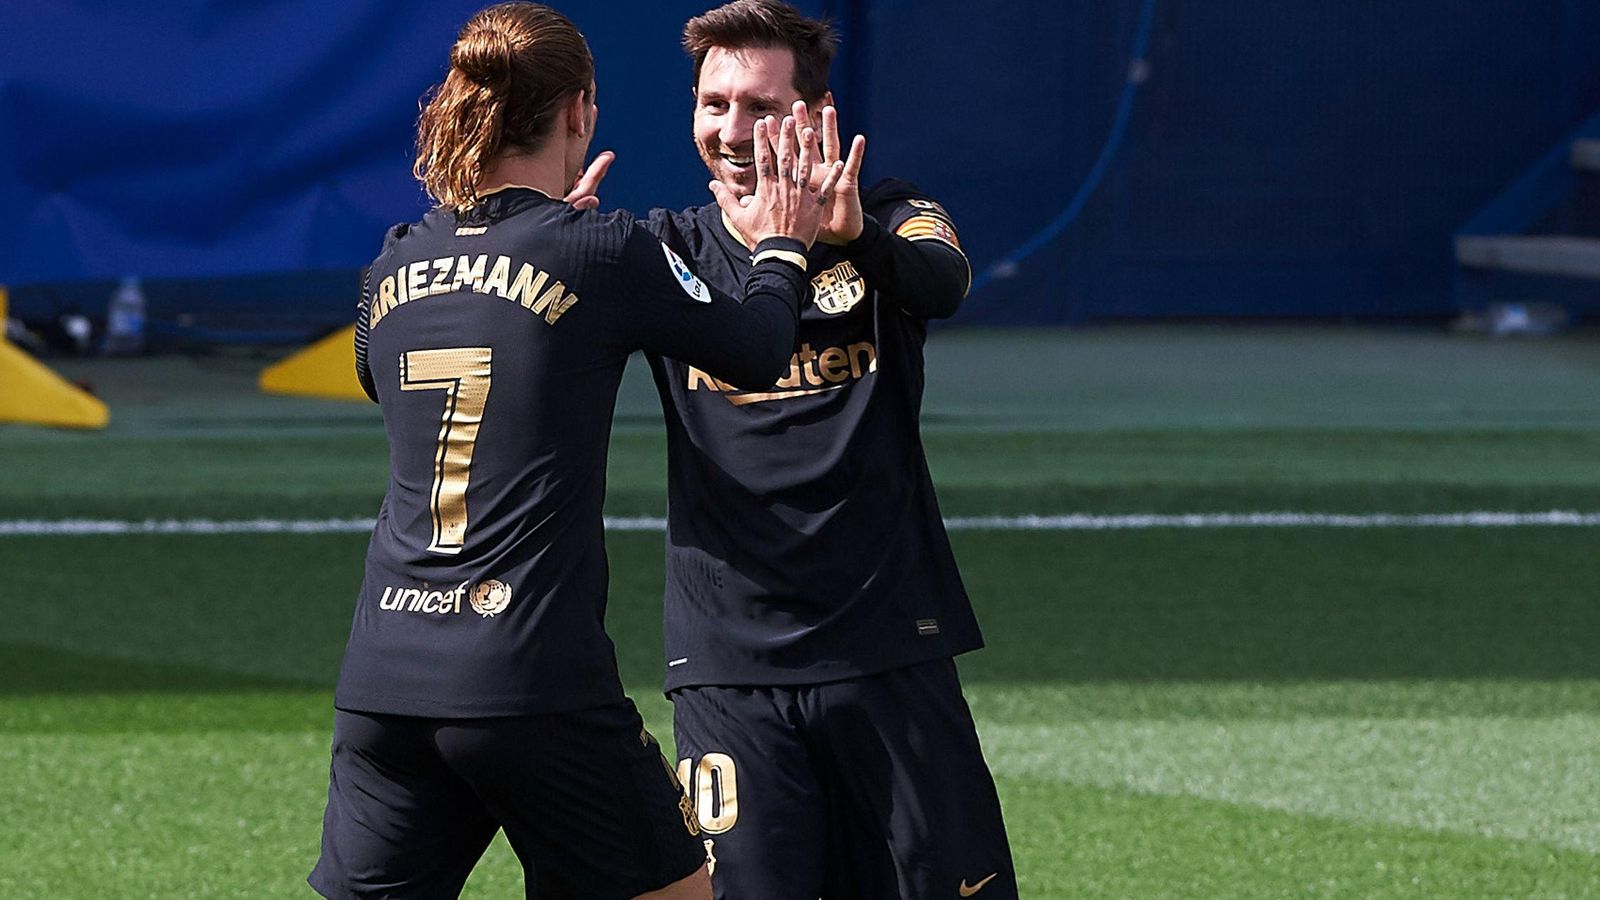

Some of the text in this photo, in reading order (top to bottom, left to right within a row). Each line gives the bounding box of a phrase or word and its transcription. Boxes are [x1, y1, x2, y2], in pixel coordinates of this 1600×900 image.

[369, 255, 579, 326] GRIEZMANN
[687, 341, 877, 391] uten
[399, 347, 492, 555] 7
[379, 579, 471, 614] unicef
